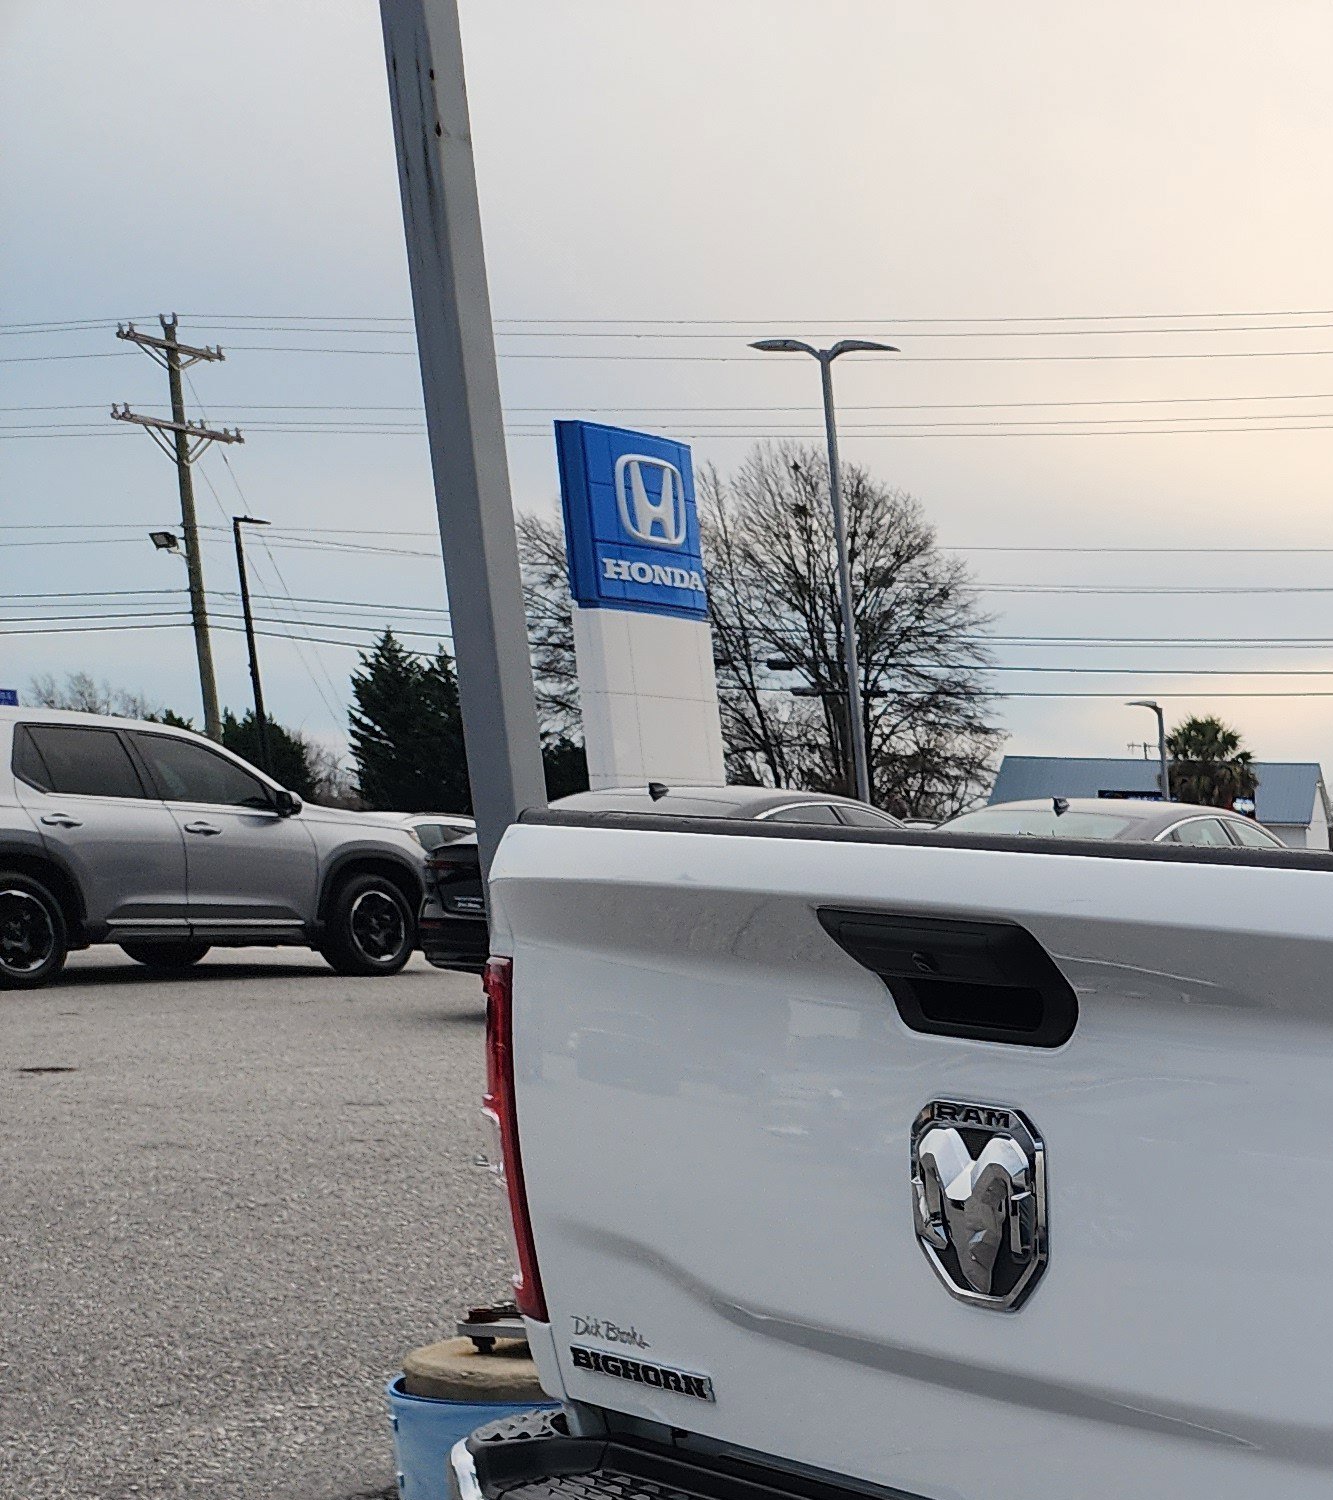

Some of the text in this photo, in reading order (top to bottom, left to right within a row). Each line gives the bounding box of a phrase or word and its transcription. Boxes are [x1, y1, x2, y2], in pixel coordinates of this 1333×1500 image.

[602, 557, 705, 592] HONDA
[934, 1102, 1011, 1130] RAM
[570, 1315, 604, 1339] Dick
[569, 1345, 710, 1401] BIGHORN
